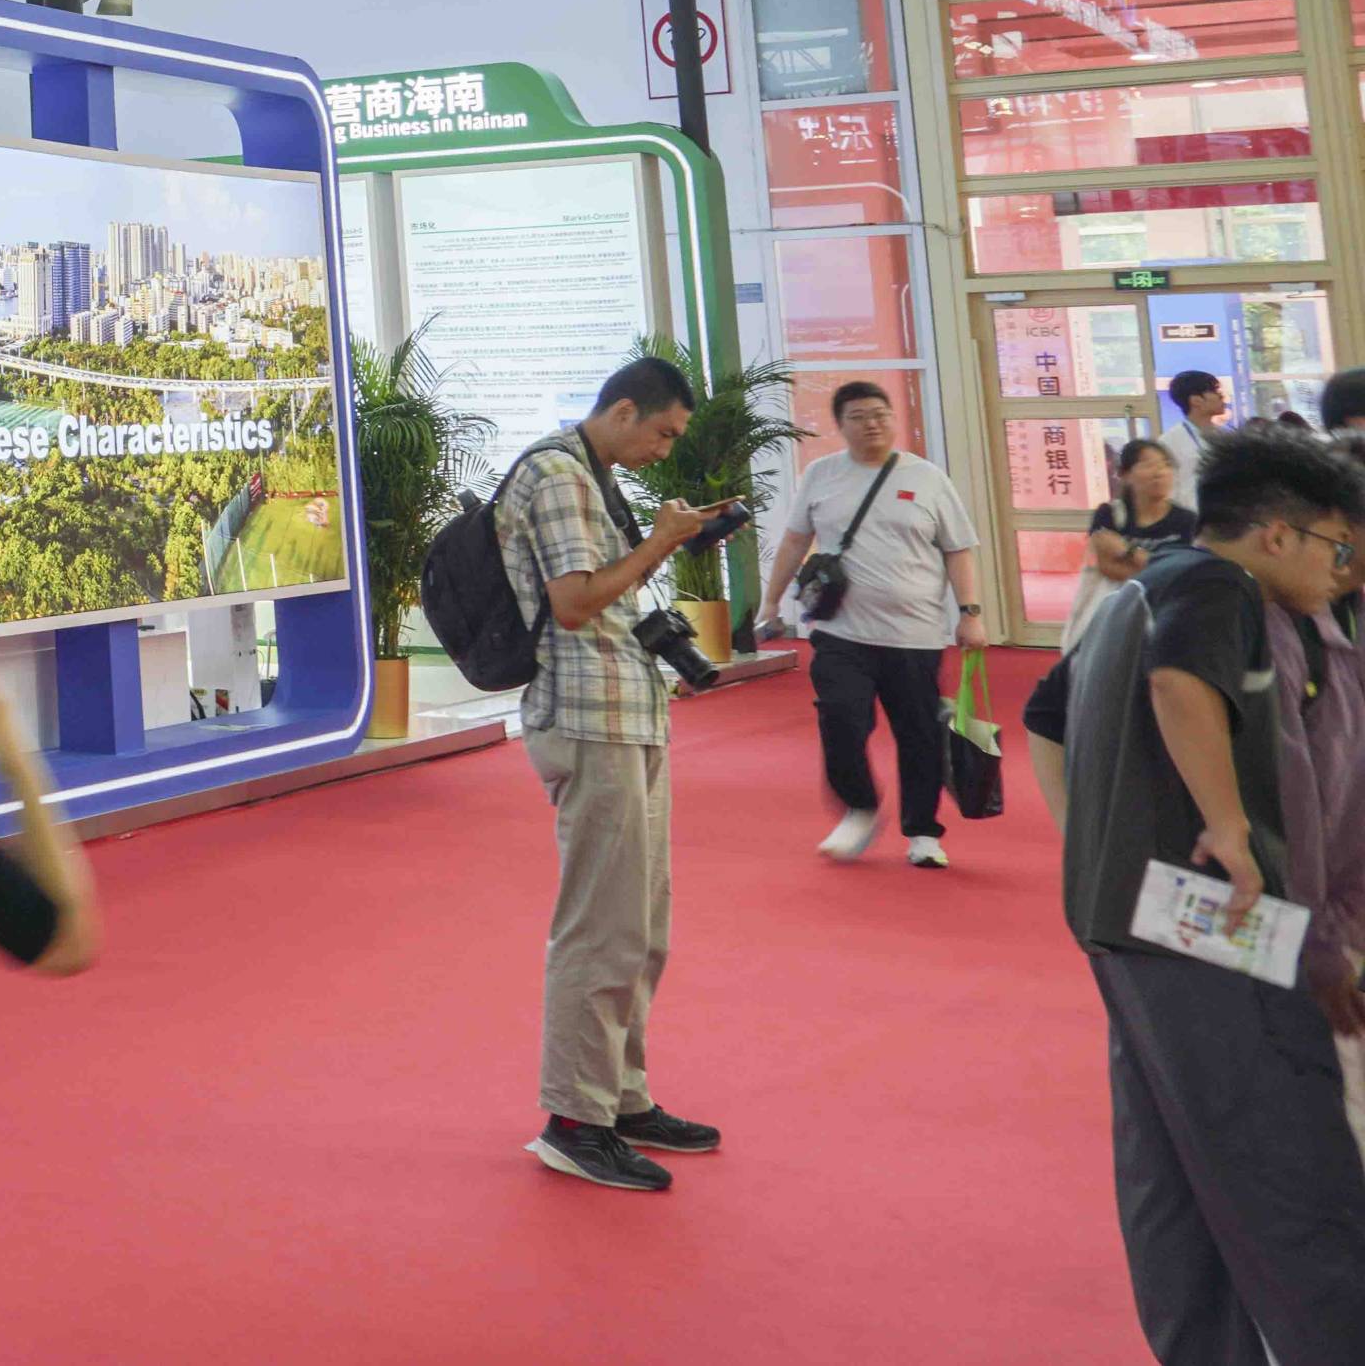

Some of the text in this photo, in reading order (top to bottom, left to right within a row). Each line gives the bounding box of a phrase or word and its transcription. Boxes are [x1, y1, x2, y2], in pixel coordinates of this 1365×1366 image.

[324, 72, 485, 124] 营商海南
[349, 120, 430, 139] Business
[433, 115, 453, 133] in
[457, 112, 528, 131] Hainan
[1026, 326, 1062, 338] ICBC
[57, 411, 274, 459] Characteristics
